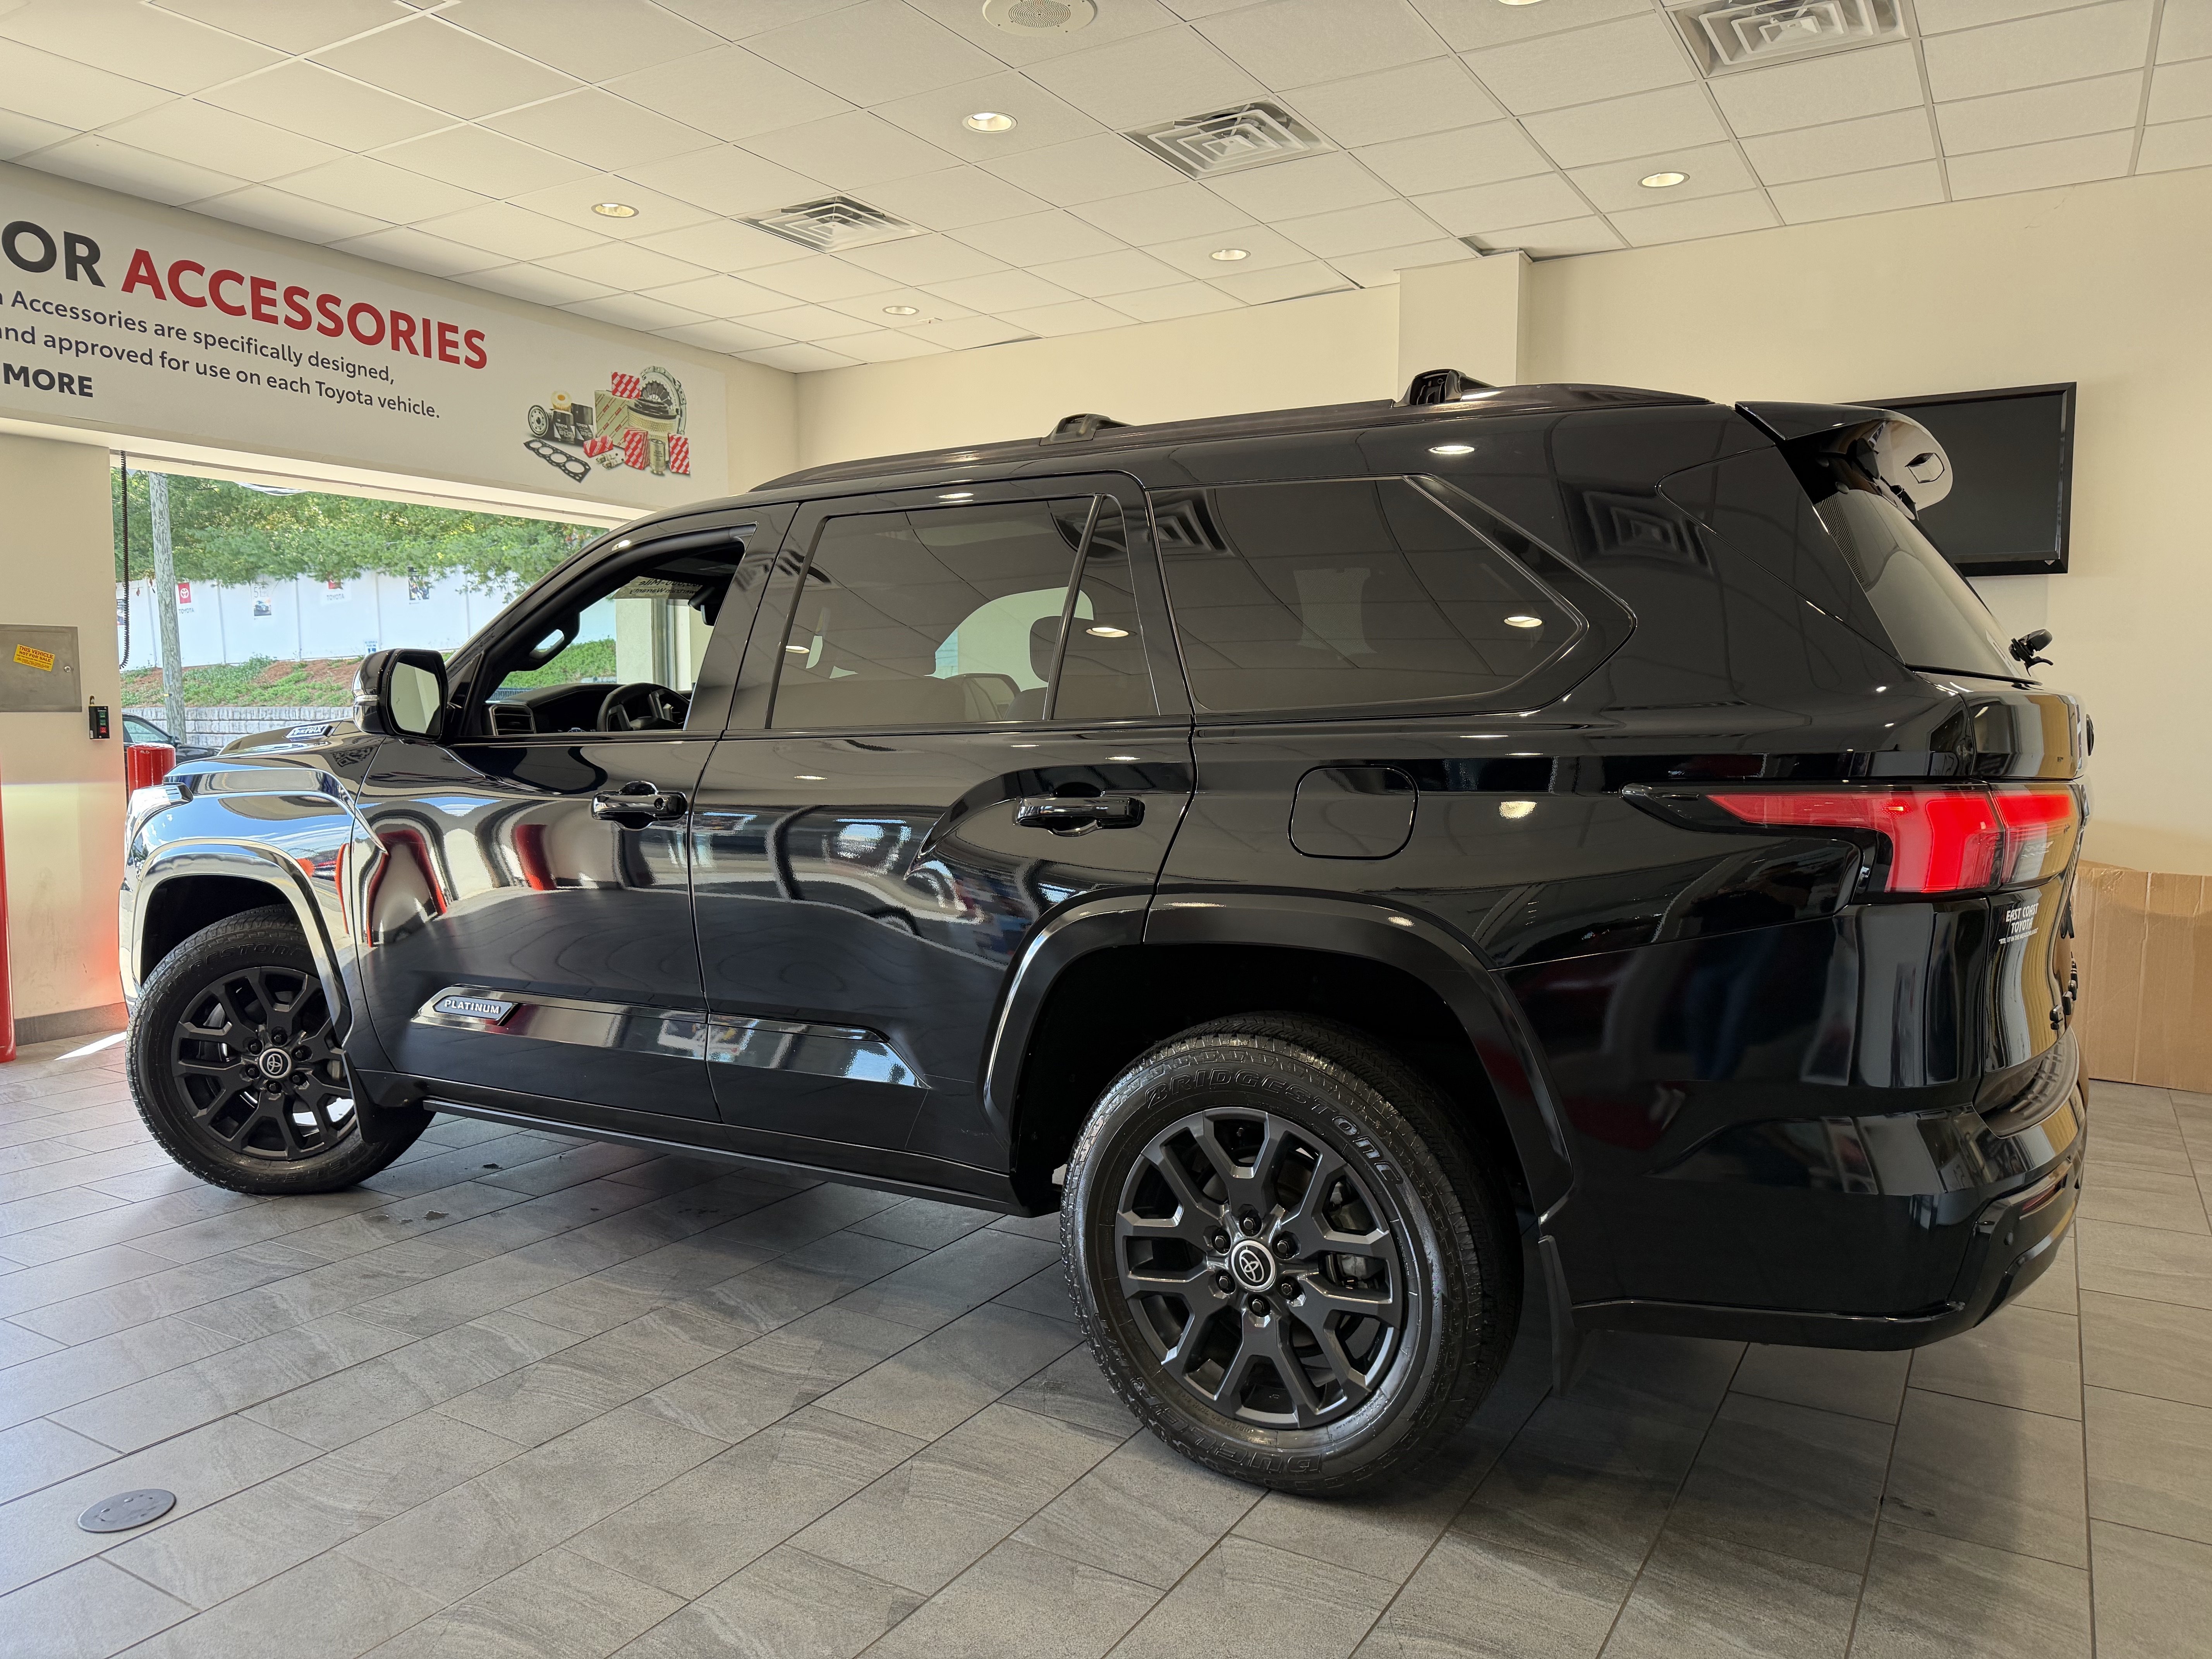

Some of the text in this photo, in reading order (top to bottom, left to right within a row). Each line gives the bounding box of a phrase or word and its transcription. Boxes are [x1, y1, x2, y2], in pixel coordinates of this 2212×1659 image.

[2, 221, 487, 369] OR ACCESSORIES
[11, 290, 394, 385] Accessories are specifically designed,
[0, 326, 439, 418] nd approved for use on each Toyota vehicle.
[3, 363, 93, 398] MORE
[32, 649, 53, 659] VEHICLE
[2006, 903, 2039, 922] EAST COAST
[2011, 917, 2033, 934] TOYOTA
[444, 999, 500, 1014] PLATINUM
[1145, 1067, 1404, 1185] BRIDGESTONE
[1130, 1377, 1322, 1474] DUELER
